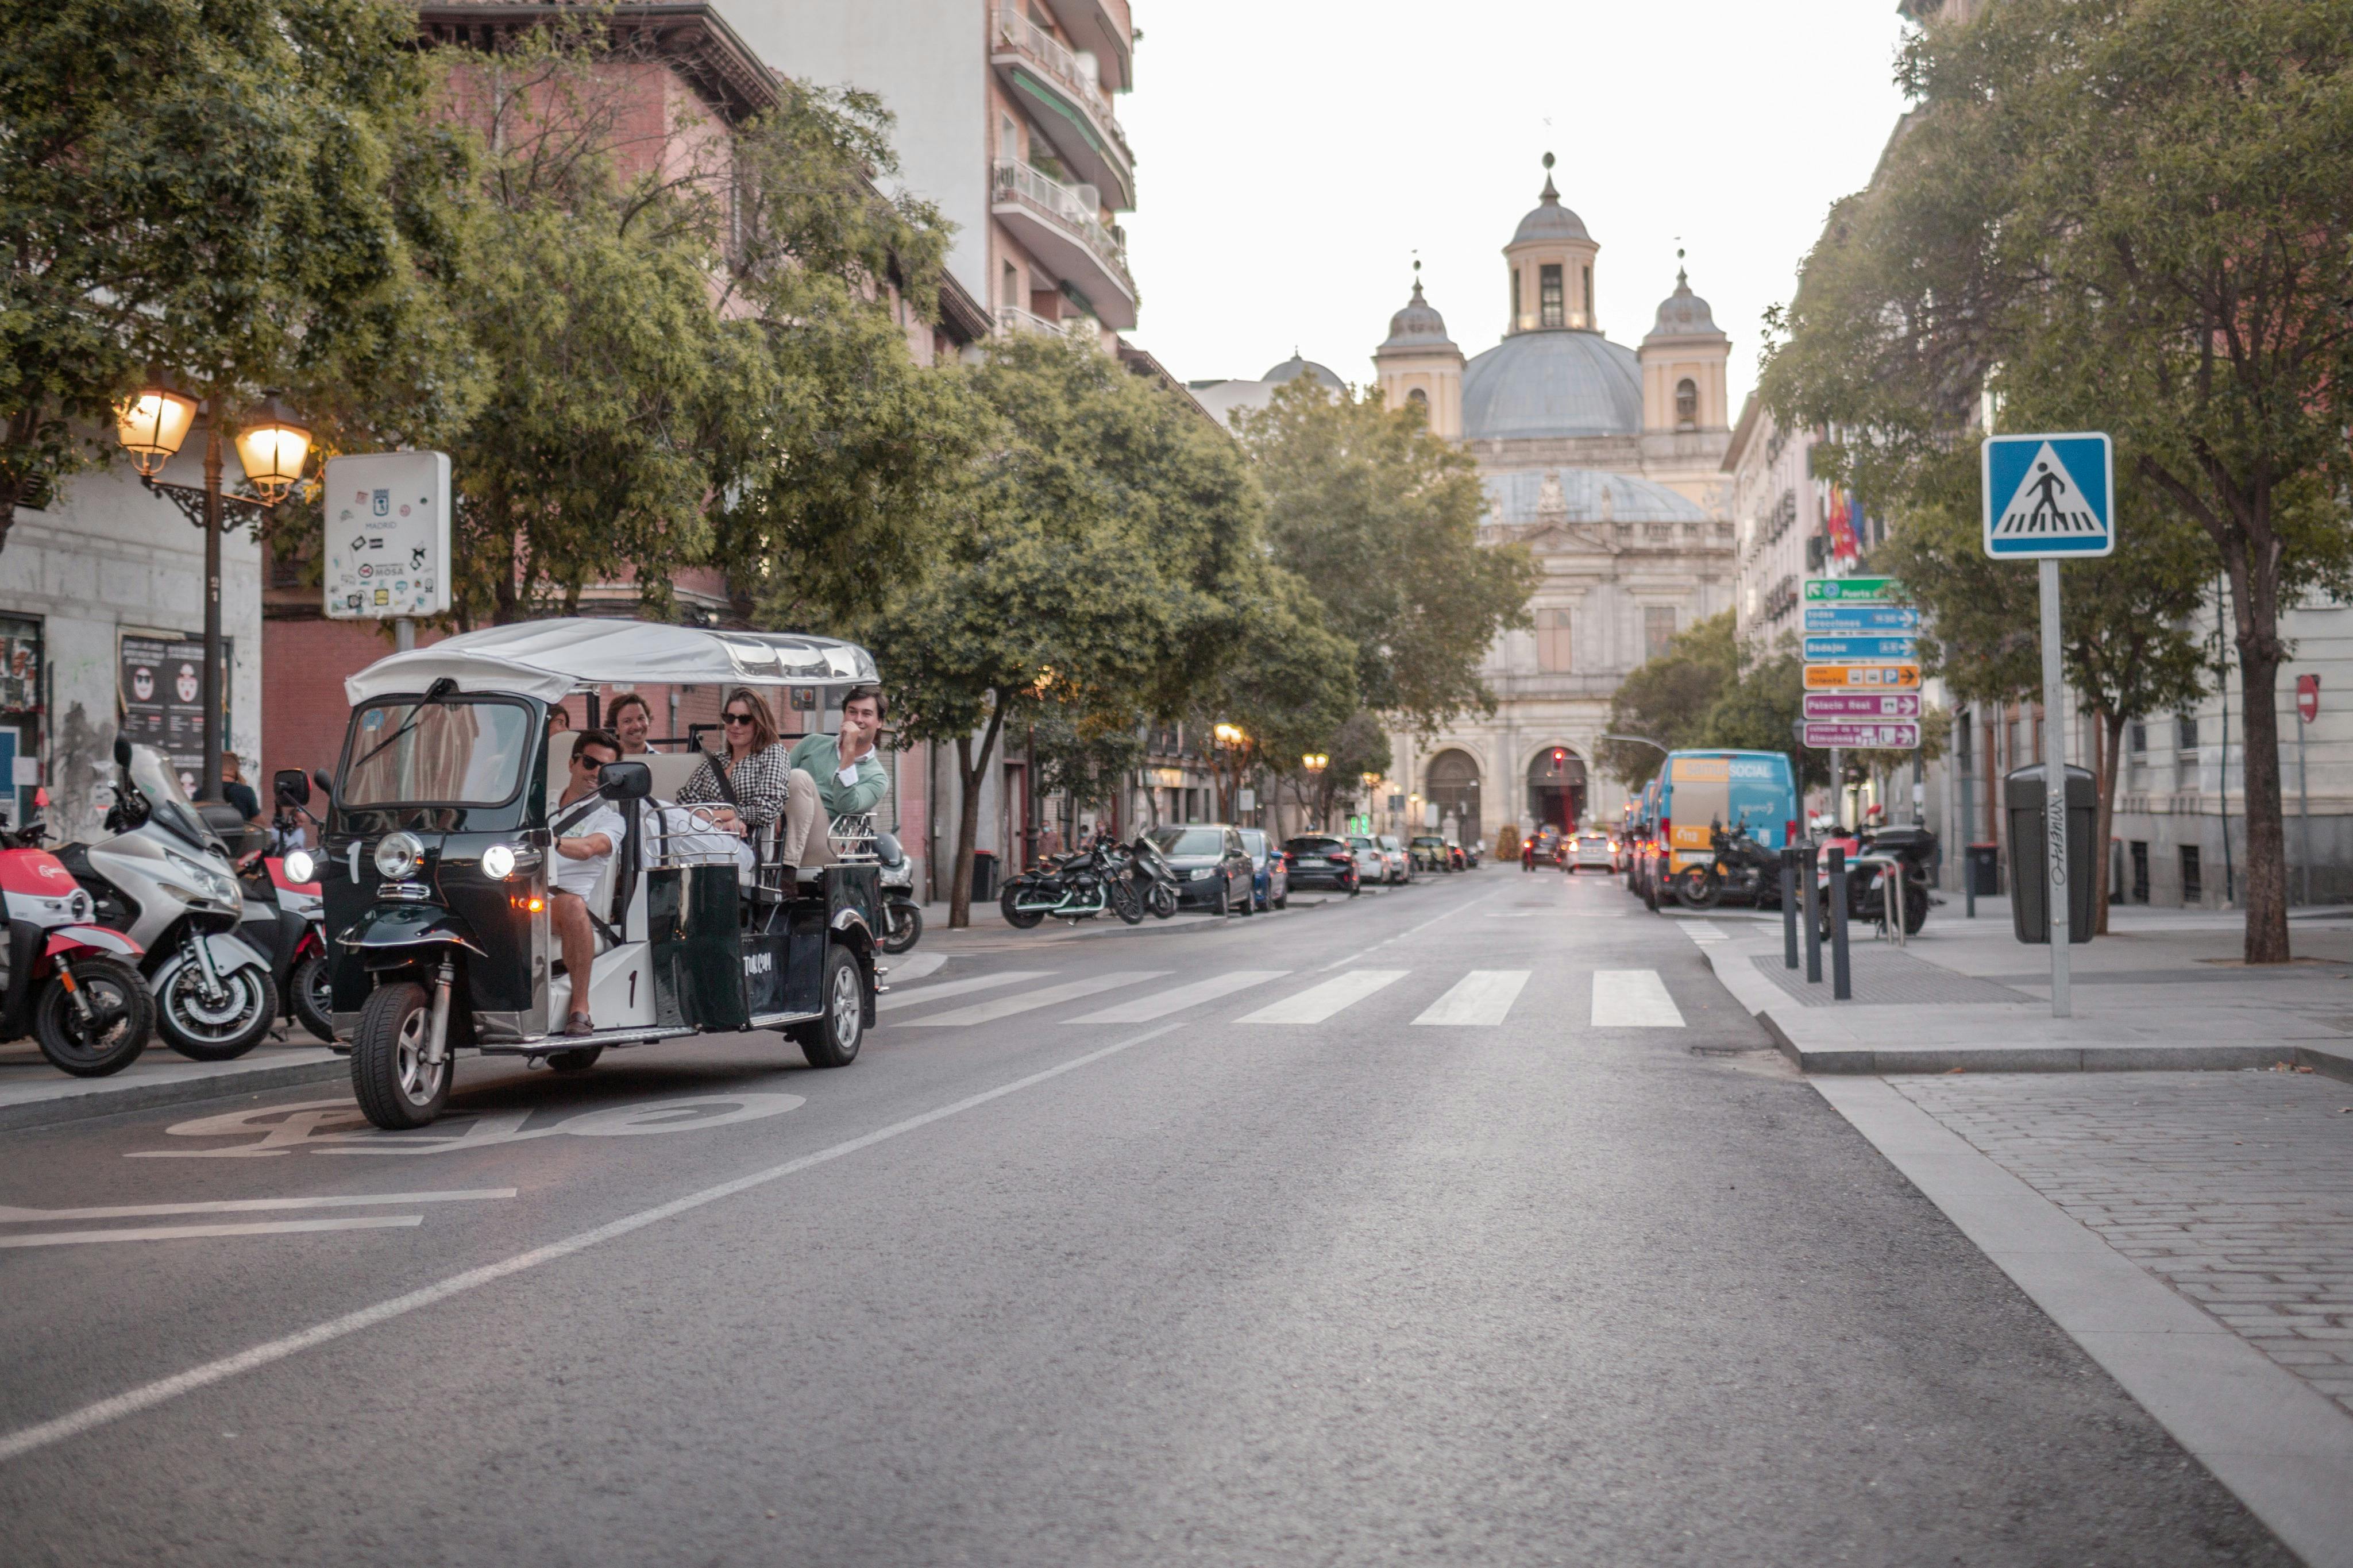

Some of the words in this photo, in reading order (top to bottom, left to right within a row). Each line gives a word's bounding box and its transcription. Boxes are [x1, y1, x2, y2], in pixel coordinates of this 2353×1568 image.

[365, 521, 396, 530] MADRID
[375, 569, 404, 577] MOSA
[1808, 643, 1847, 654] Badajoz
[1810, 677, 1842, 685] Oriente
[1808, 700, 1844, 710] Palacio
[1848, 700, 1871, 710] Real
[1810, 734, 1854, 743] Almudena
[1729, 763, 1772, 778] SOCIAL
[346, 840, 362, 885] 1
[628, 970, 638, 1009] 1
